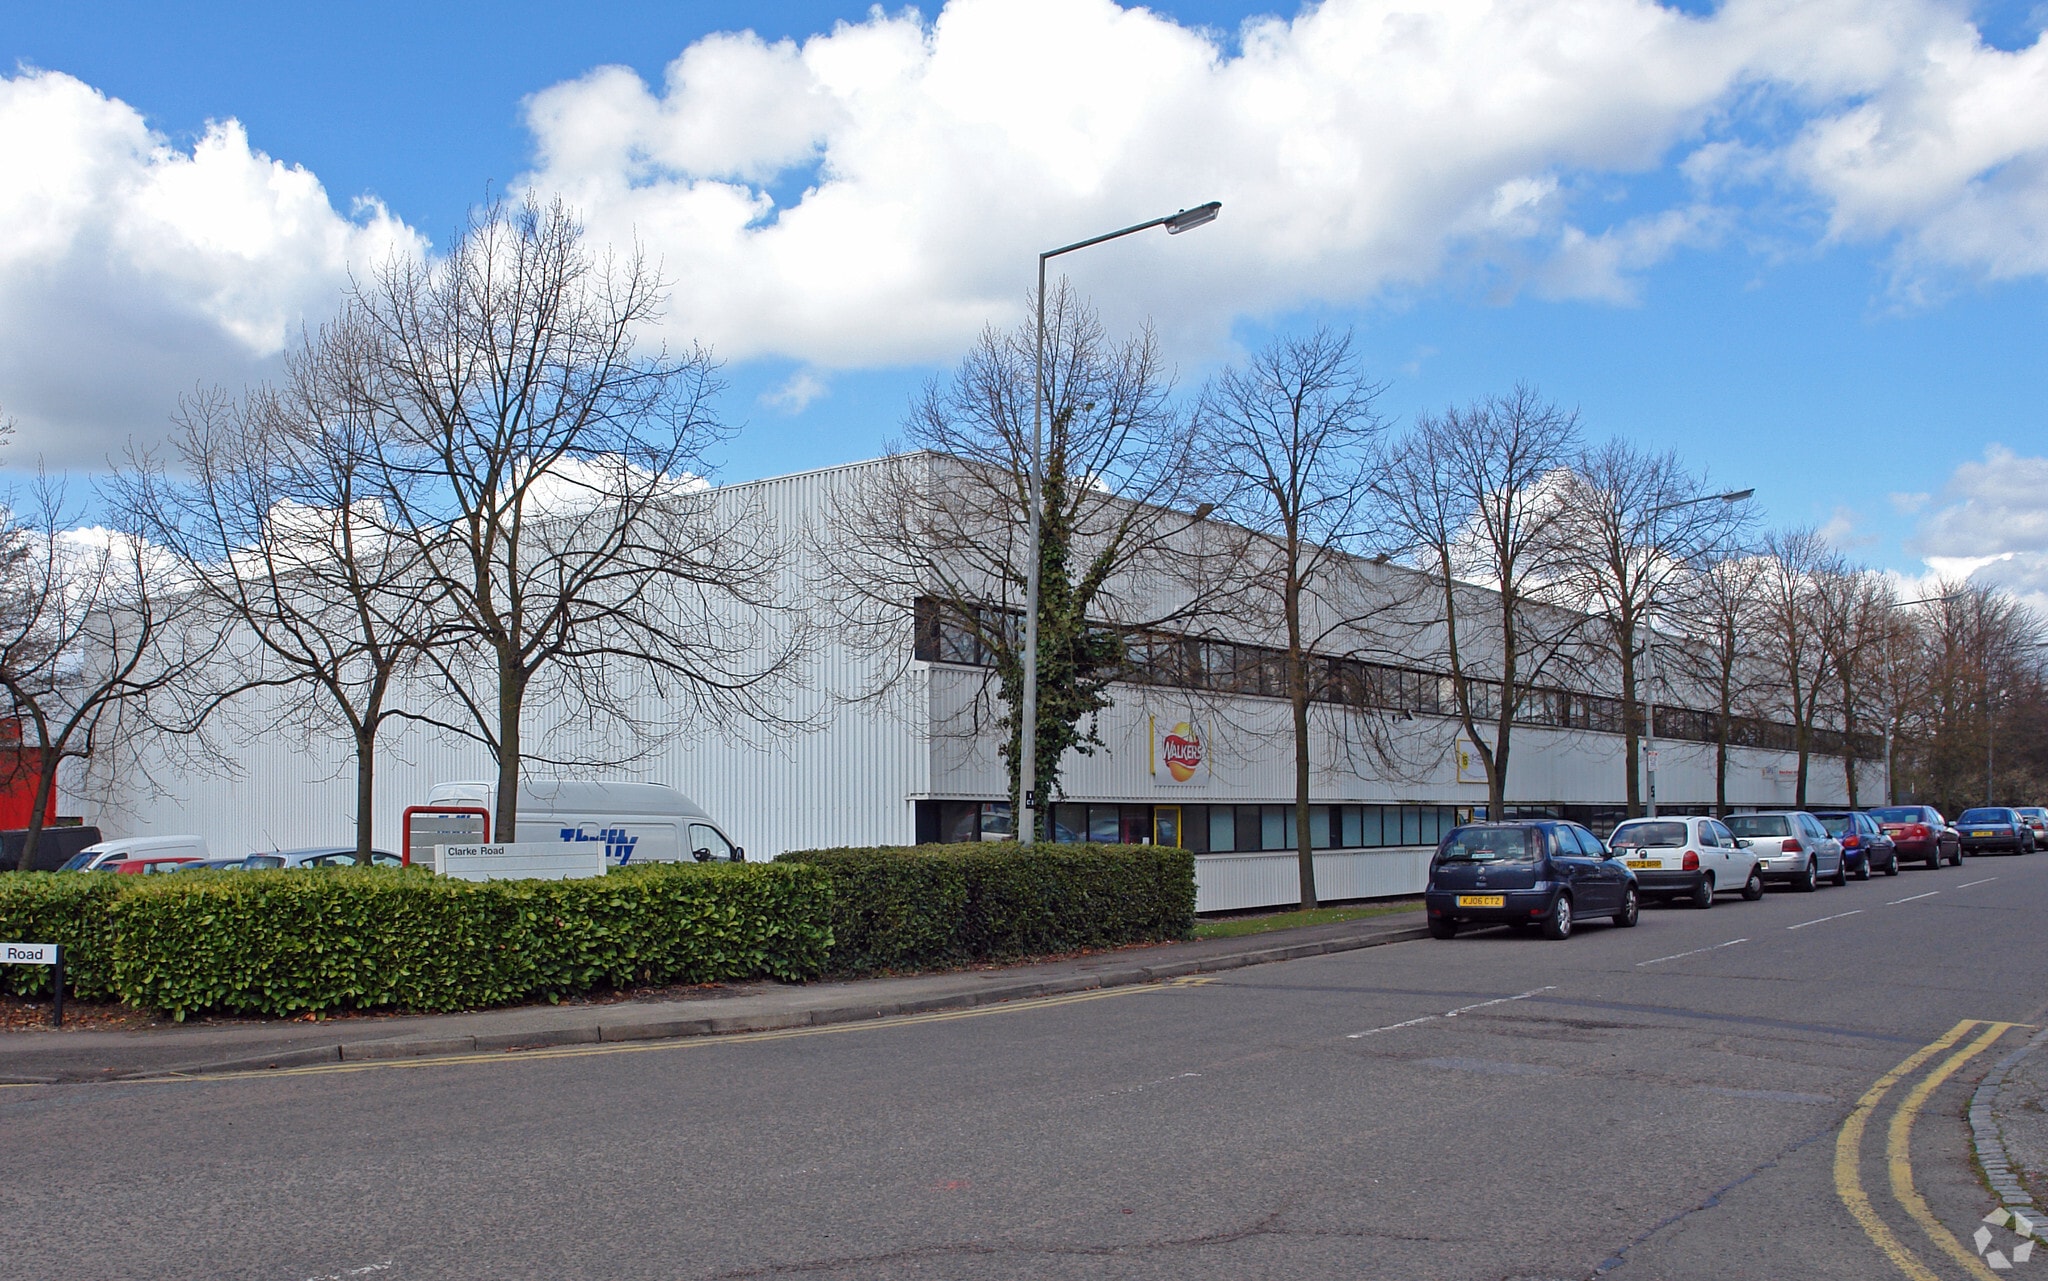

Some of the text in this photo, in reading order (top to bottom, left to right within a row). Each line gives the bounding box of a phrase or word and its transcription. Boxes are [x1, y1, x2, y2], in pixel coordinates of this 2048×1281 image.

[1163, 741, 1202, 760] WALKERS
[448, 846, 505, 856] Clarke Road
[560, 828, 639, 865] Thifty
[1462, 897, 1500, 905] KJ06 CTZ
[8, 947, 44, 960] Road
